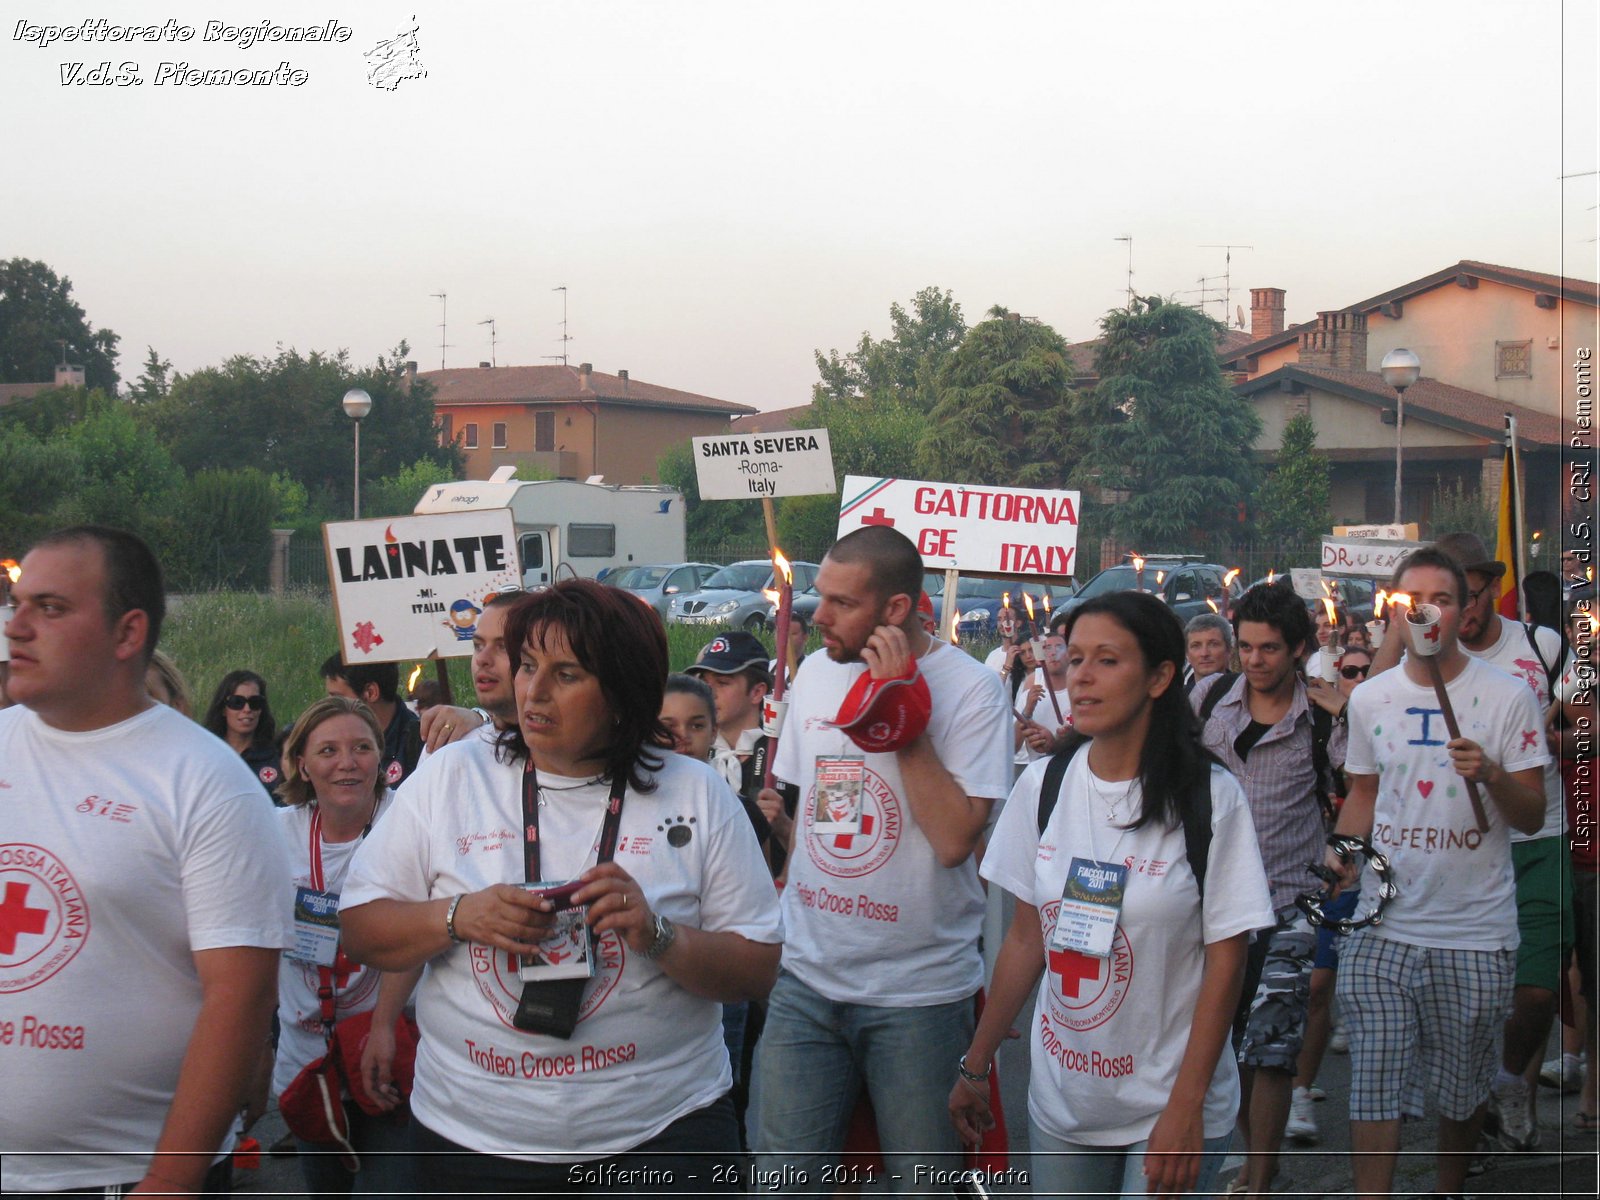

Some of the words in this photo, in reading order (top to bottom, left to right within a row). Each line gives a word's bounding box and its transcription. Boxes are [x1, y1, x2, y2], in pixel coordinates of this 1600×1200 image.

[702, 440, 750, 458] SANTA
[754, 435, 819, 455] SEVERA
[748, 477, 776, 496] Italy
[914, 486, 1078, 526] GATTORNA
[336, 534, 507, 584] LAINATE
[918, 528, 957, 558] GE
[1000, 543, 1075, 575] ITALY
[411, 602, 446, 615] ITALIA
[1405, 706, 1446, 747] I
[753, 747, 766, 777] Canon
[870, 778, 898, 842] ITALIANA
[1077, 866, 1118, 883] FIACCOLATA
[1088, 879, 1105, 890] 2011
[0, 848, 46, 872] OSSA
[45, 863, 85, 939] ITALIANA
[818, 887, 853, 915] Croce
[857, 895, 899, 923] Rossa
[600, 931, 620, 969] IANA
[1091, 989, 1121, 1022] MONTECELIO
[20, 1015, 86, 1050] Rossa
[464, 1039, 516, 1079] Trofeo
[521, 1050, 575, 1079] Croce
[581, 1042, 637, 1073] Rossa
[1091, 1050, 1134, 1079] Rossa
